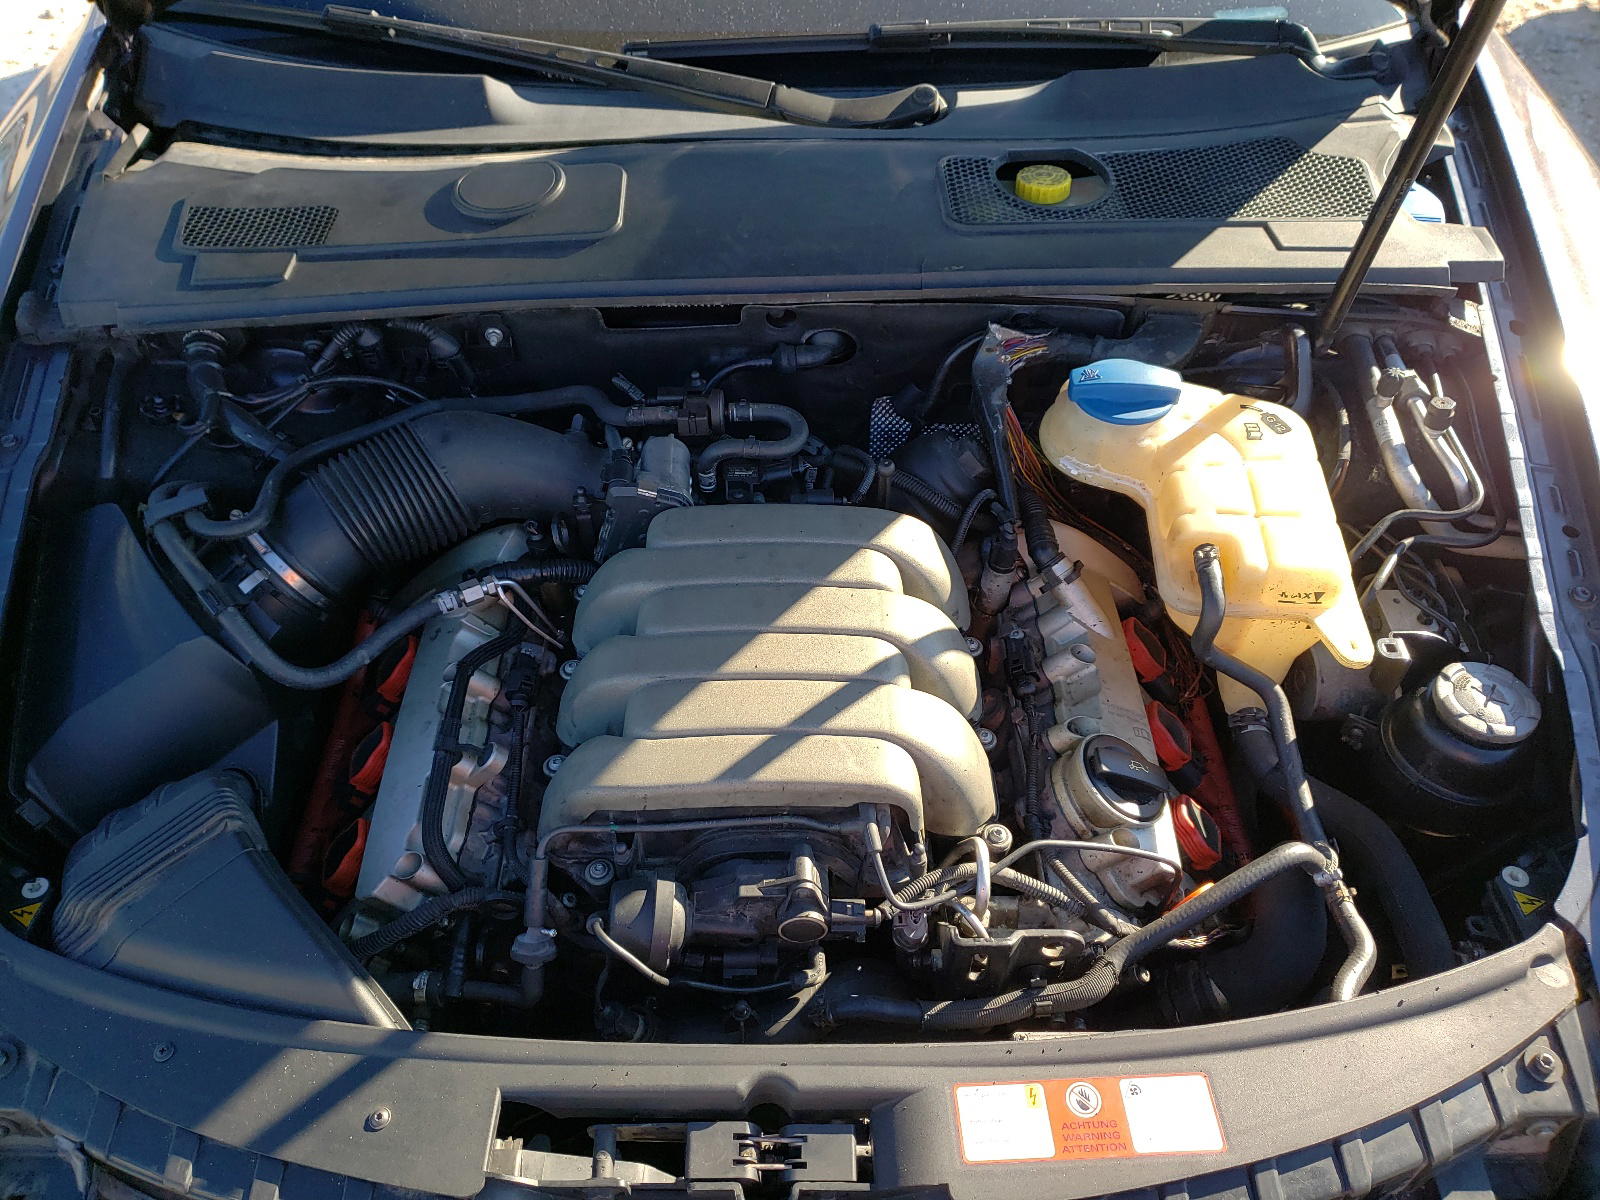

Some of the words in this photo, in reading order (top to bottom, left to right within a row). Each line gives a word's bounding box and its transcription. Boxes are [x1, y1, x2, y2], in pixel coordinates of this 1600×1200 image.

[1061, 1120, 1117, 1130] ACHTUNG
[1062, 1131, 1120, 1141] WARNING
[1062, 1142, 1127, 1153] ATTENTION
